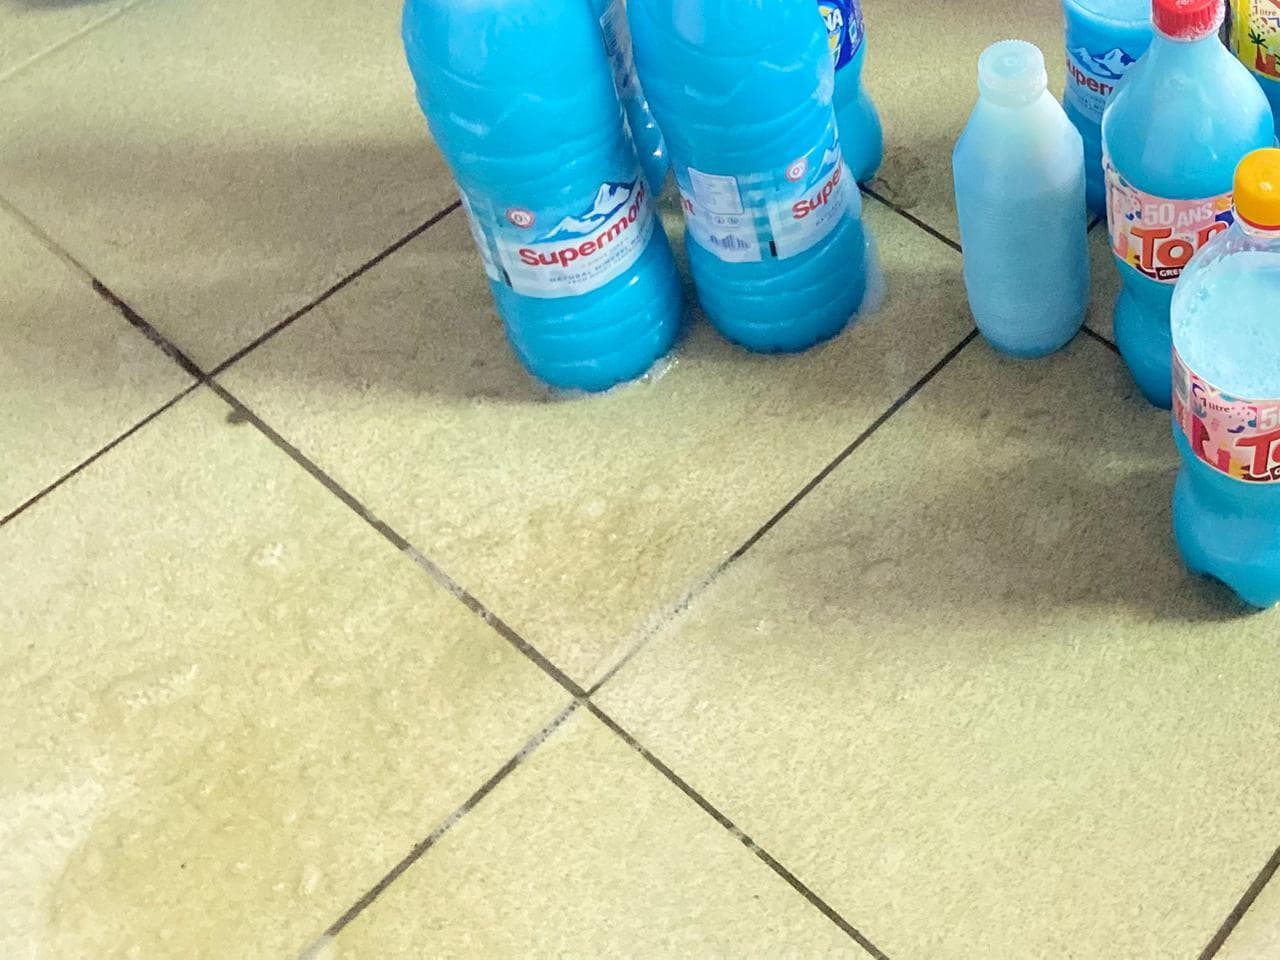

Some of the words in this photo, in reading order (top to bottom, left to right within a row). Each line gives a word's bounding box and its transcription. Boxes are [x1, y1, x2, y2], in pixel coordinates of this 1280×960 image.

[1144, 203, 1175, 226] 50
[1176, 202, 1212, 227] ANS
[1208, 402, 1231, 413] litre
